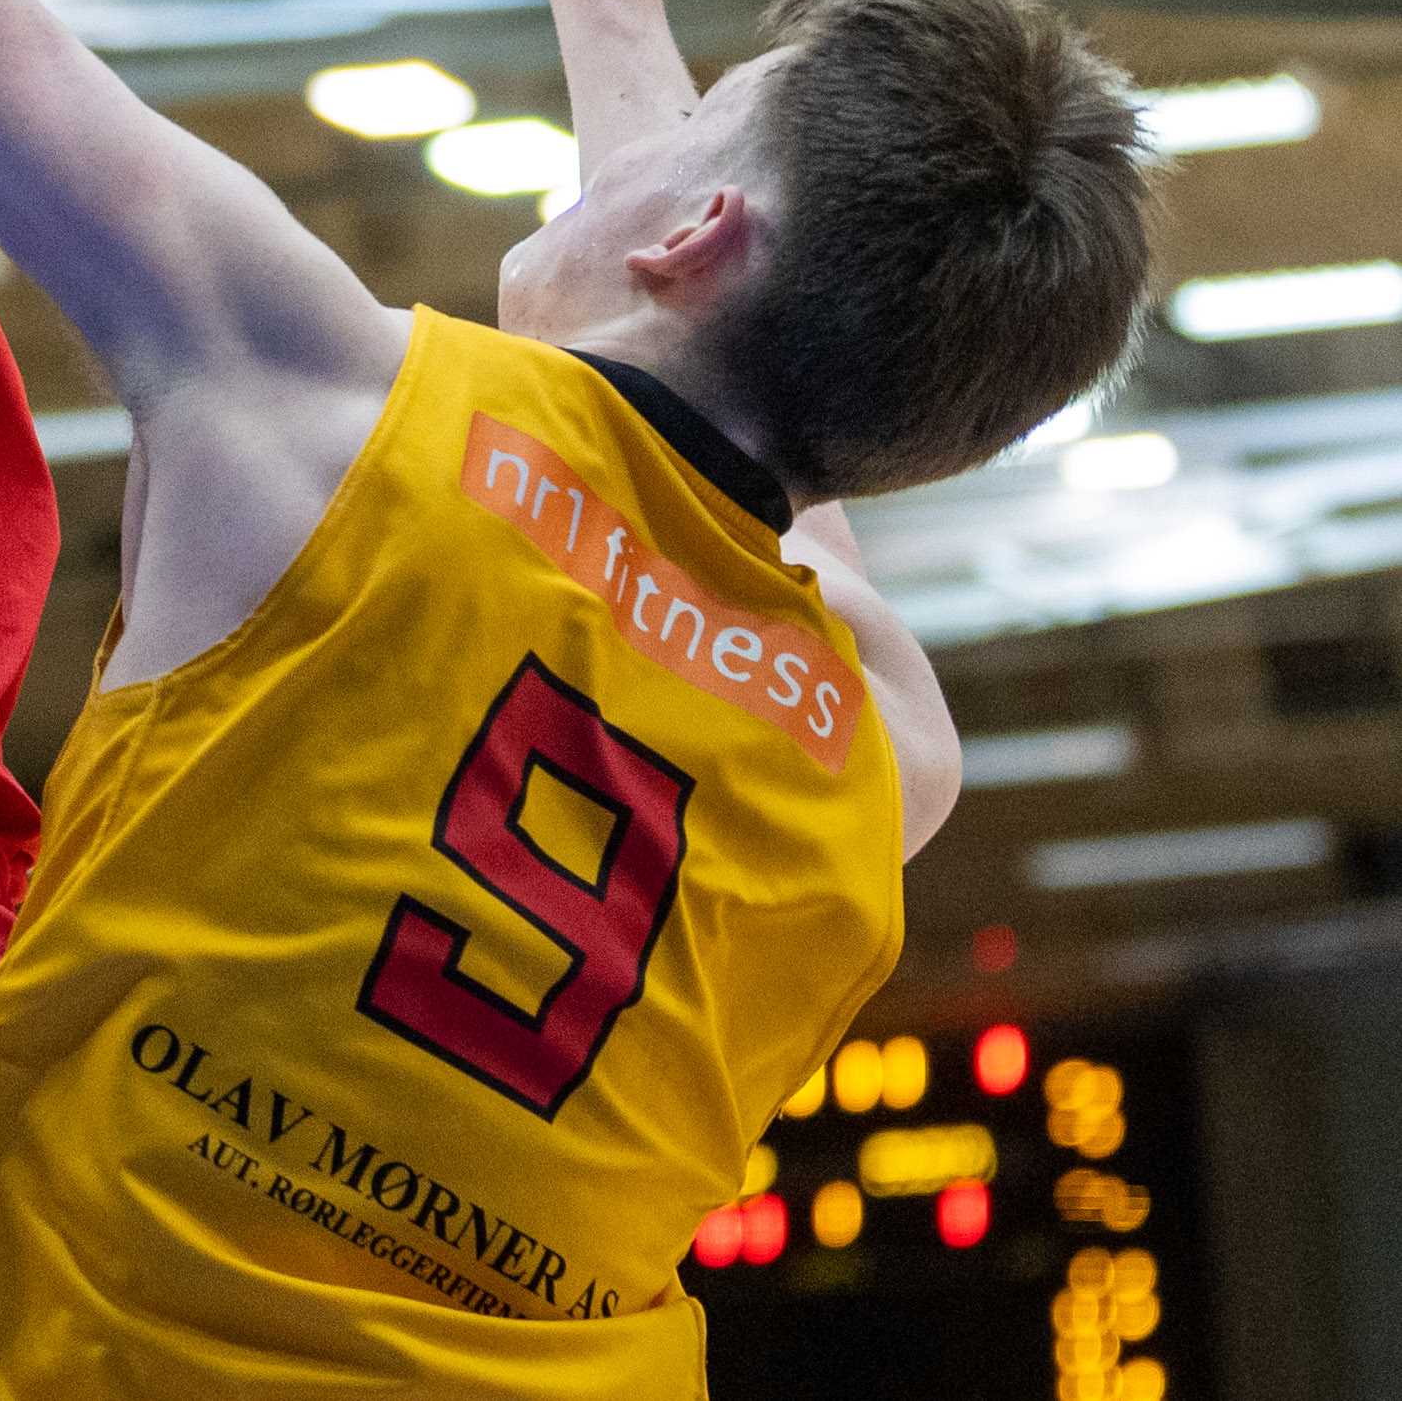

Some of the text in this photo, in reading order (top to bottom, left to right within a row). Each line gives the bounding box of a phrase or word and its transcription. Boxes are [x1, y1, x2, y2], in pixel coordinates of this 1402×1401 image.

[605, 526, 841, 738] fitness
[355, 650, 696, 1124] 9
[131, 1024, 312, 1144] OLAV
[309, 1119, 567, 1304] MØRNER
[566, 1276, 621, 1319] AS
[187, 1132, 527, 1319] AUT. RØRLEGGERFIR
